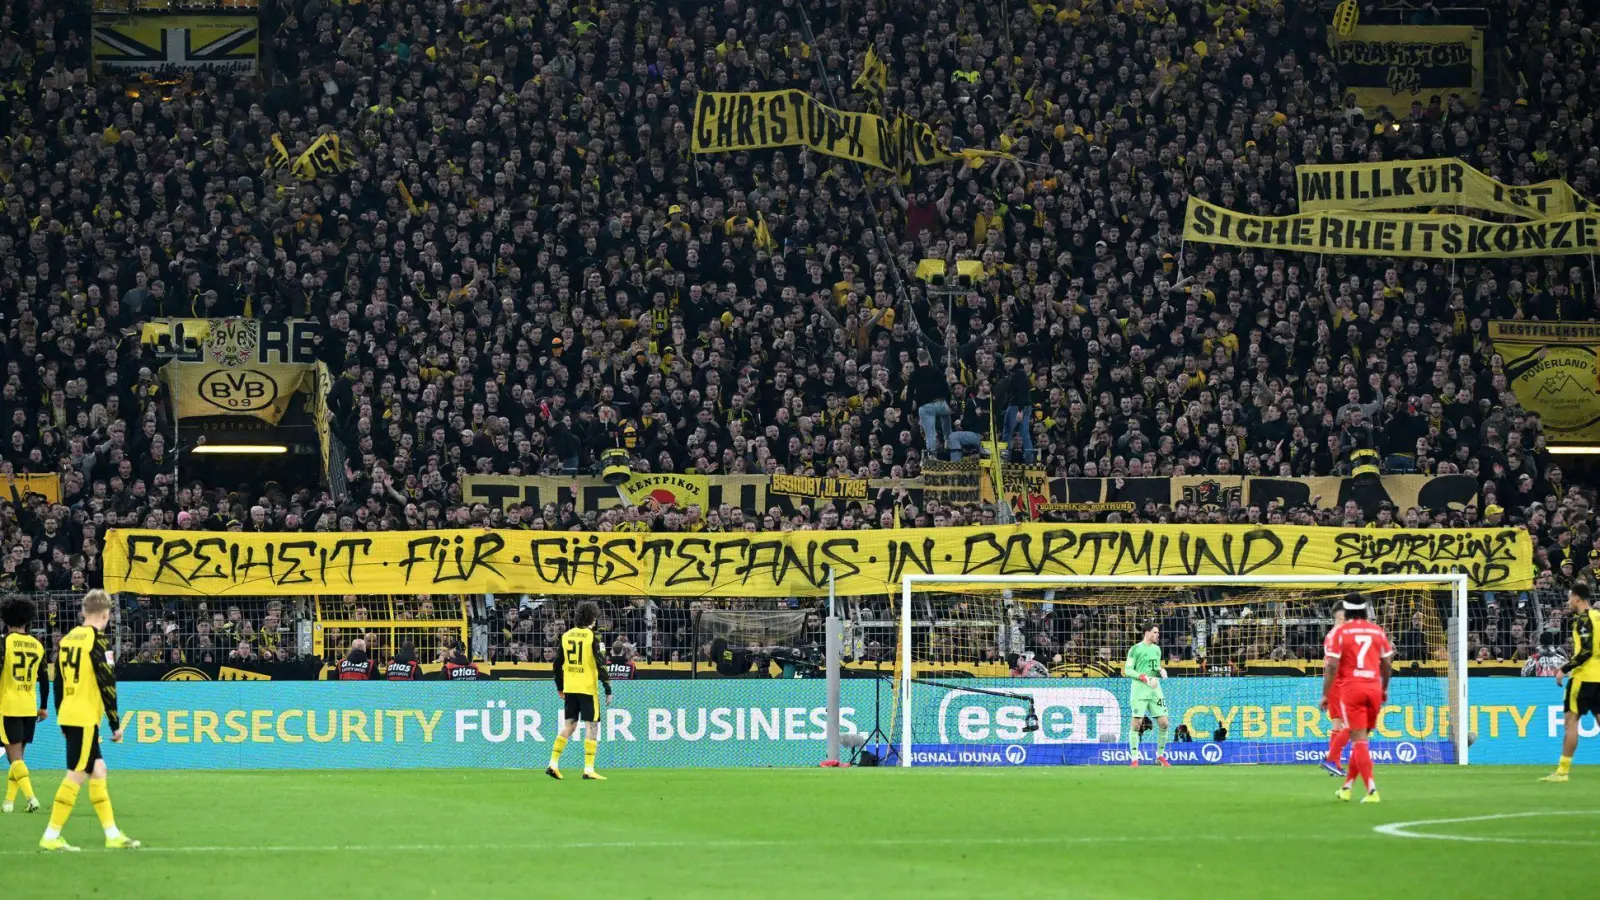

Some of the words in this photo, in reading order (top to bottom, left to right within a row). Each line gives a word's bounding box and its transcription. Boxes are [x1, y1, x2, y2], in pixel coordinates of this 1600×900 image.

[1302, 163, 1464, 202] WILLKÜR
[1521, 358, 1588, 383] POWERLAND
[210, 372, 265, 398] BVB
[228, 399, 251, 407] 09
[823, 478, 868, 498] ULTRAS
[123, 534, 373, 587] FREIHEIT
[399, 532, 507, 586] FÜR
[530, 535, 861, 588] GÄSTEFANS
[888, 536, 936, 583] IN
[60, 646, 82, 684] 24
[566, 639, 584, 666] 21
[1354, 635, 1373, 669] 7
[12, 651, 39, 682] 27
[387, 662, 412, 673] atlas
[101, 709, 444, 743] YBERSECURITY
[455, 700, 546, 742] FÜR
[648, 707, 869, 741] BUSINESS.
[959, 751, 1002, 763] IDUNA
[1295, 750, 1346, 761] SIGNL
